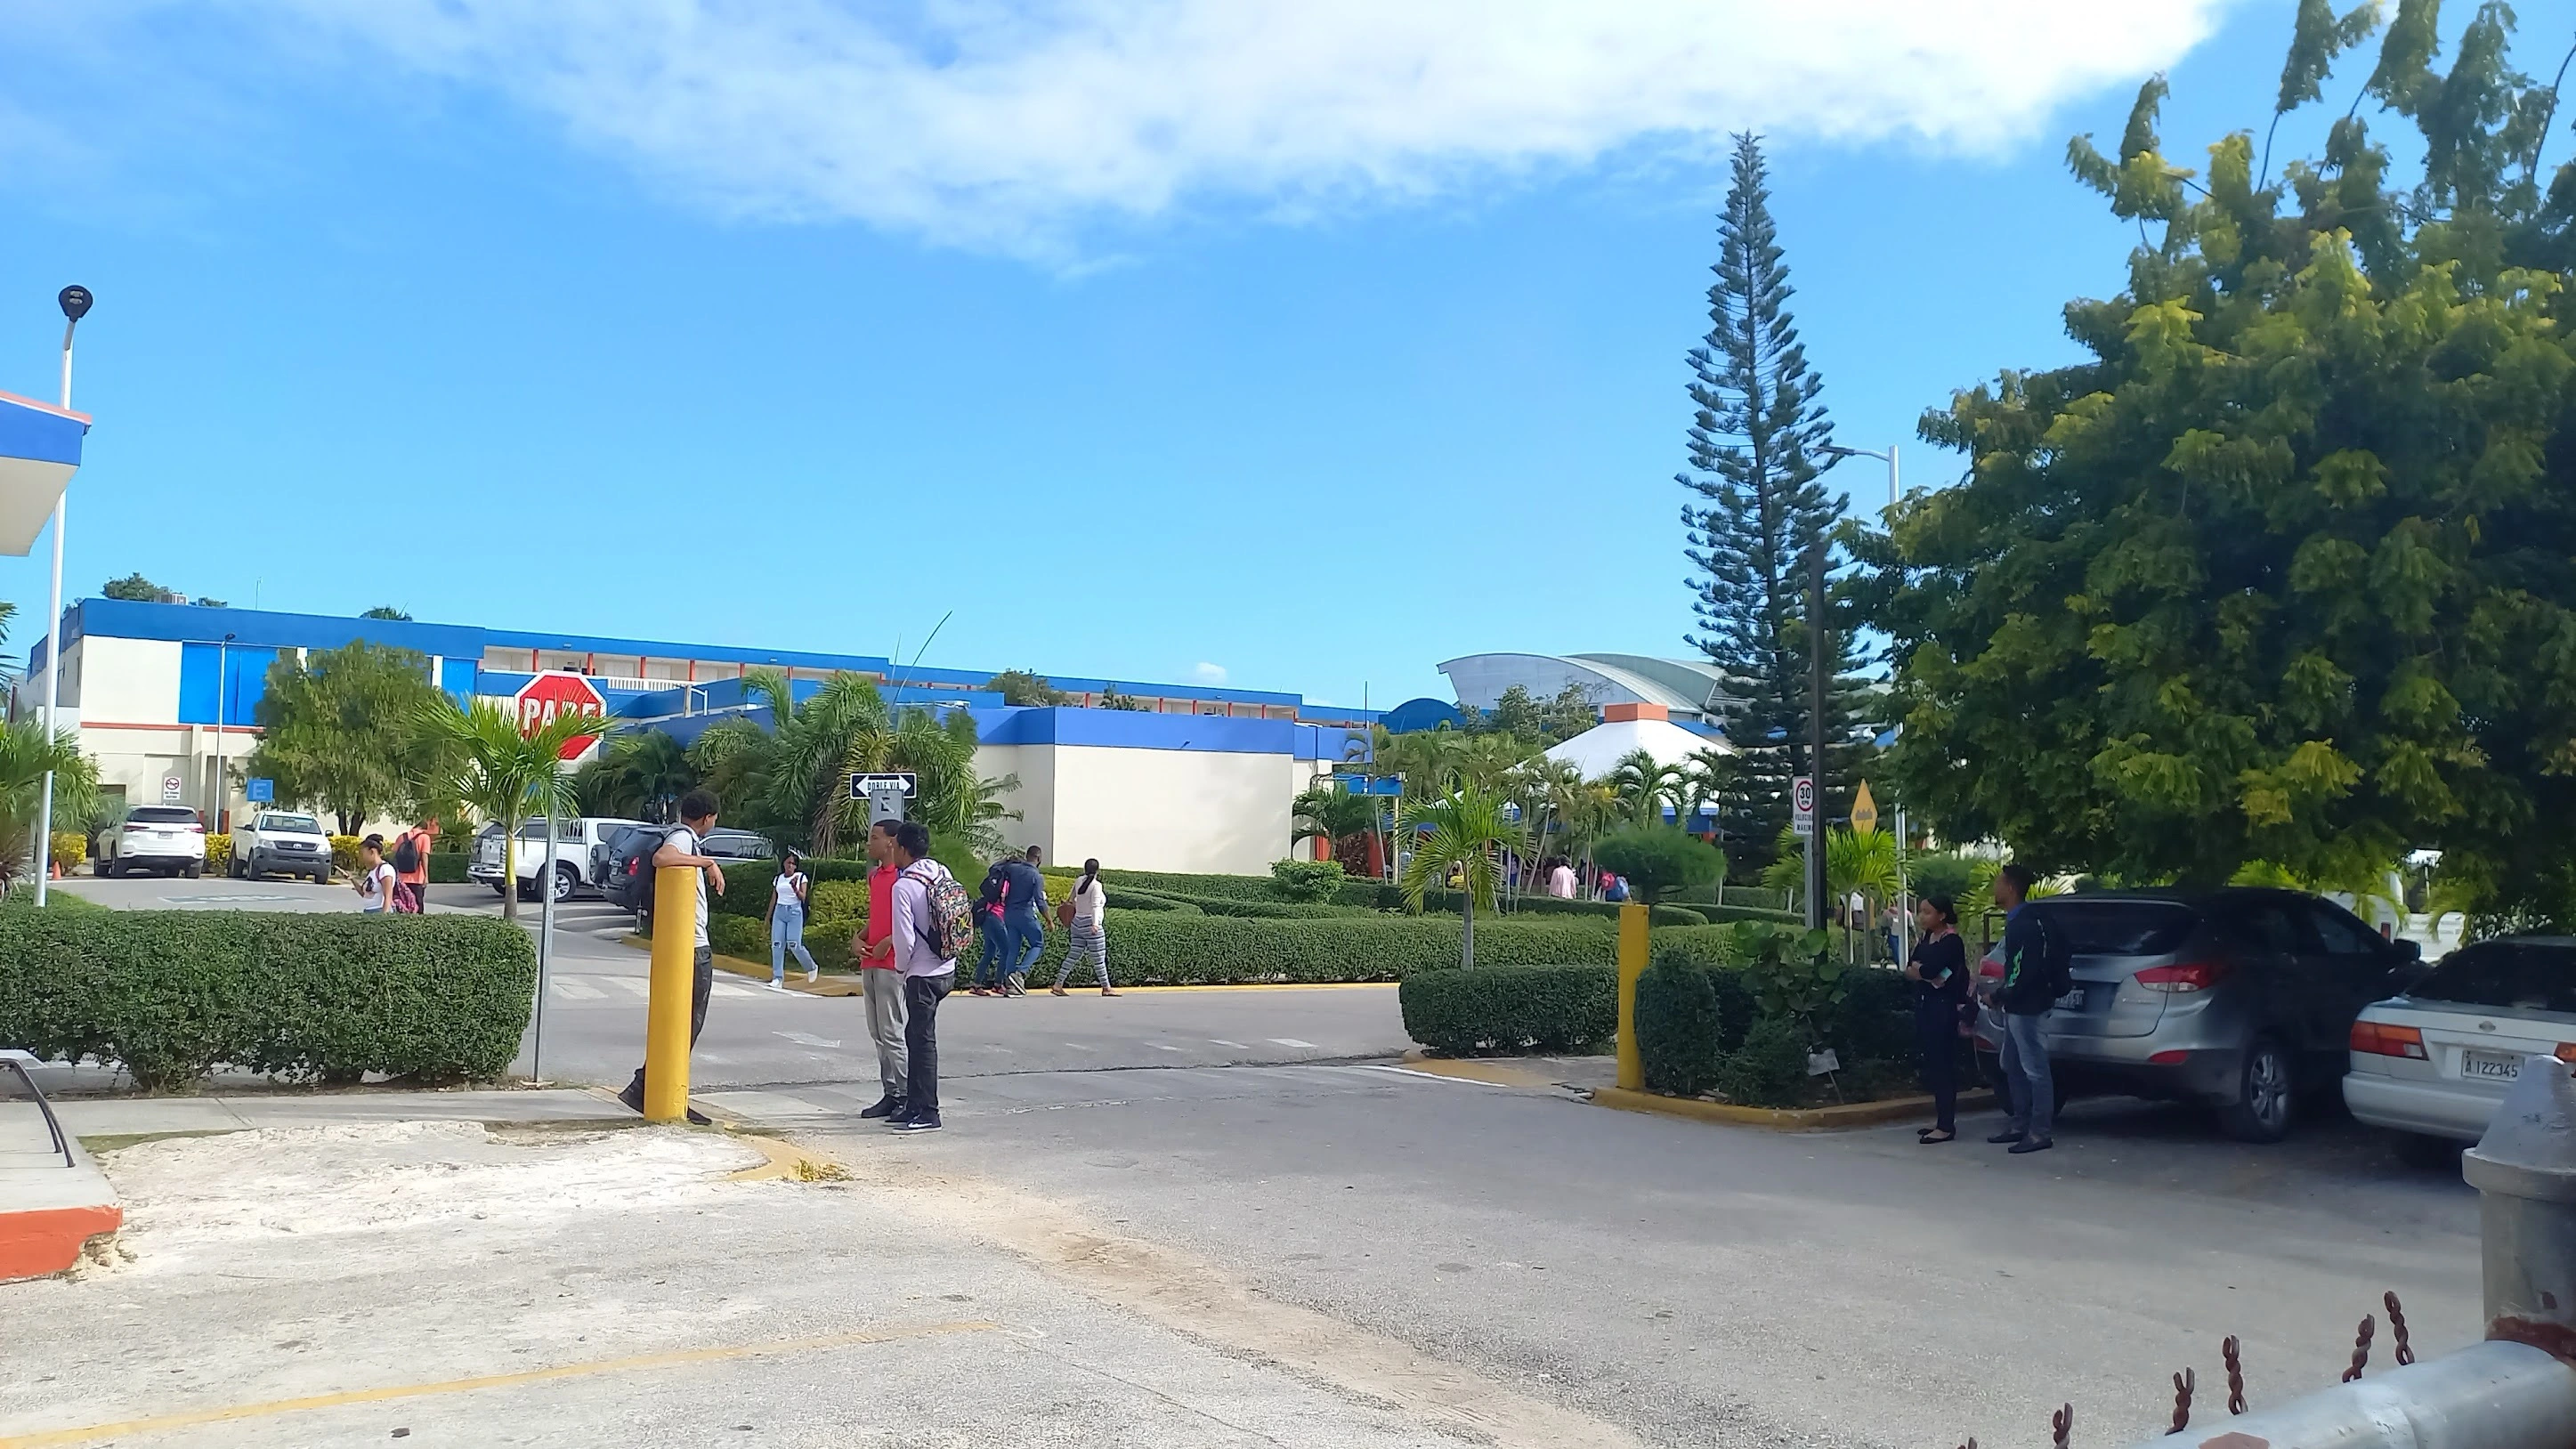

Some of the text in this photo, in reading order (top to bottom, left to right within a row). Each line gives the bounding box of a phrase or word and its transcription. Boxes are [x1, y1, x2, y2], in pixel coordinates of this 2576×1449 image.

[253, 783, 267, 798] E
[867, 781, 900, 790] DOBLE VIA
[1800, 788, 1811, 798] 30
